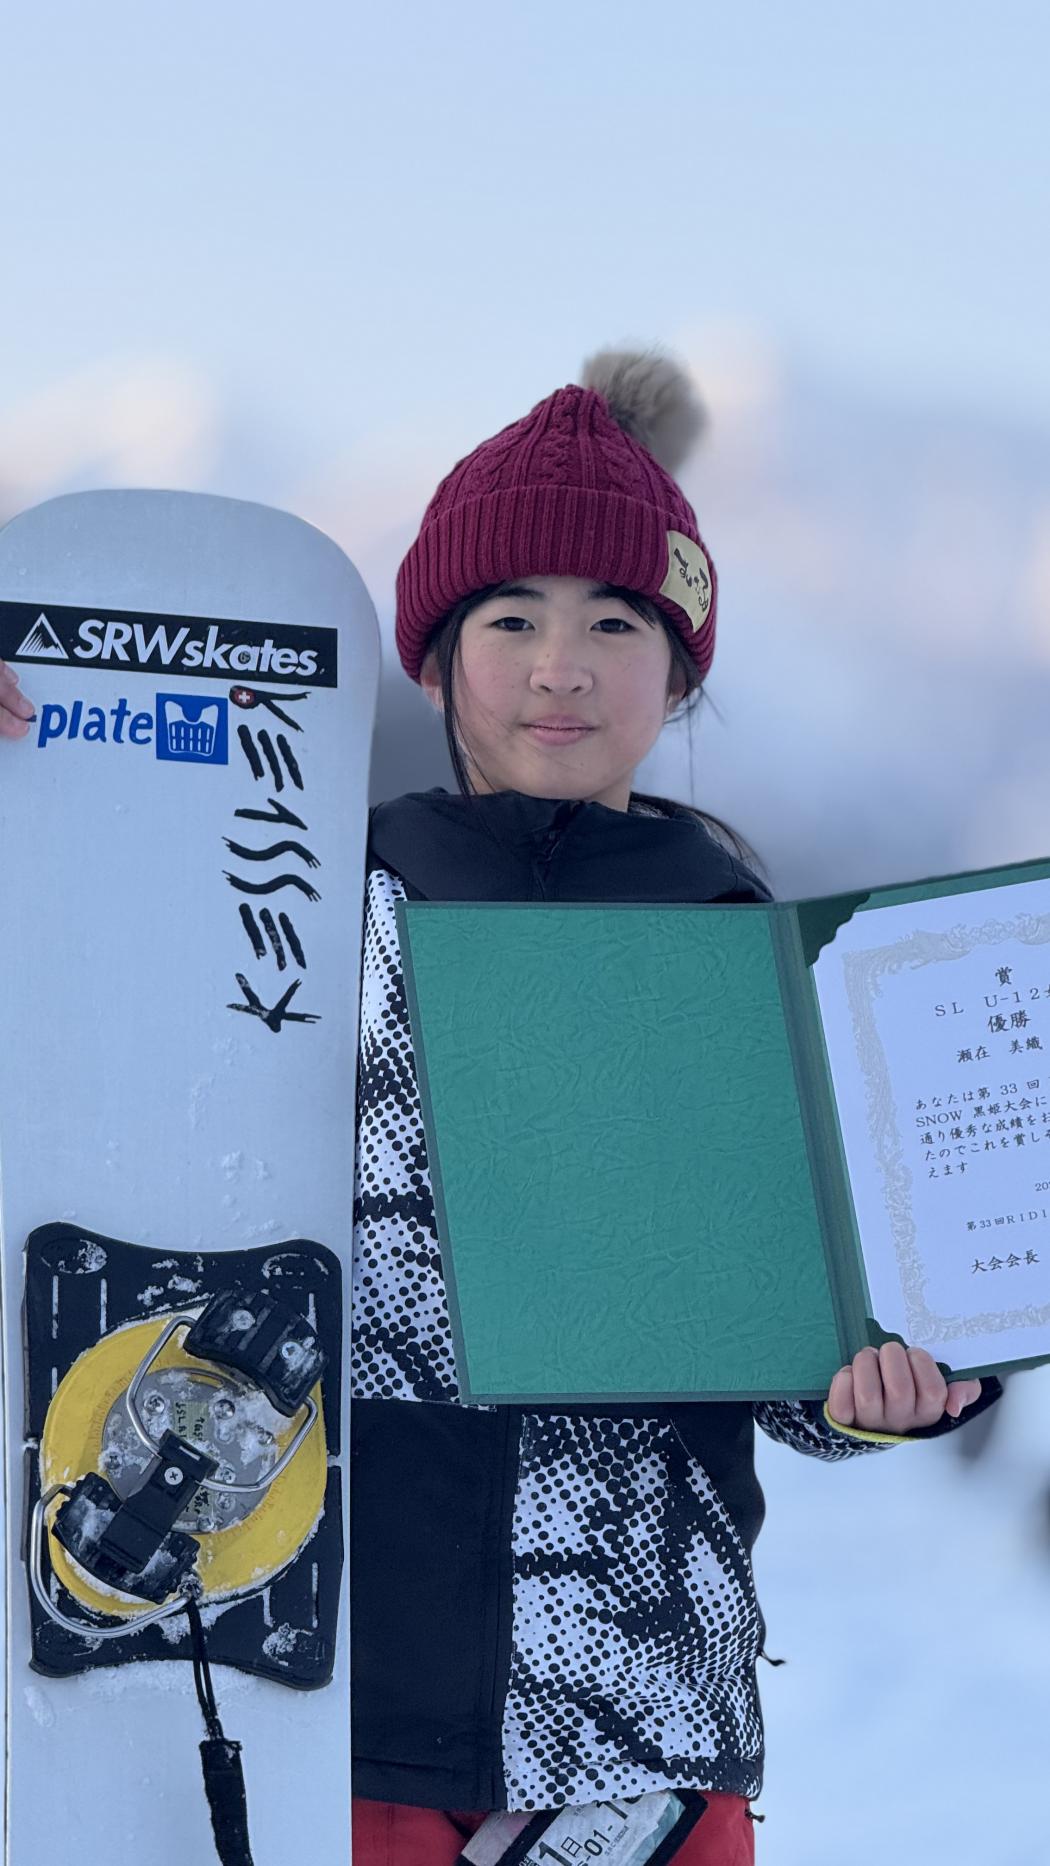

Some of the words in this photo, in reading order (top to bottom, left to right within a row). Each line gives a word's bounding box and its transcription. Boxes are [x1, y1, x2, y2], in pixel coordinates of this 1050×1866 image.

[73, 619, 318, 676] SRWskates
[995, 966, 1012, 987] 賞
[988, 1010, 1031, 1033] 優勝
[916, 1087, 991, 1110] あなたは第
[1000, 1083, 1018, 1095] 33
[1027, 1079, 1040, 1089] 回
[916, 1110, 962, 1127] SNOW
[973, 1096, 1047, 1118] 黒姫大会に
[929, 1161, 968, 1178] えます
[971, 1249, 1040, 1274] 大会会長
